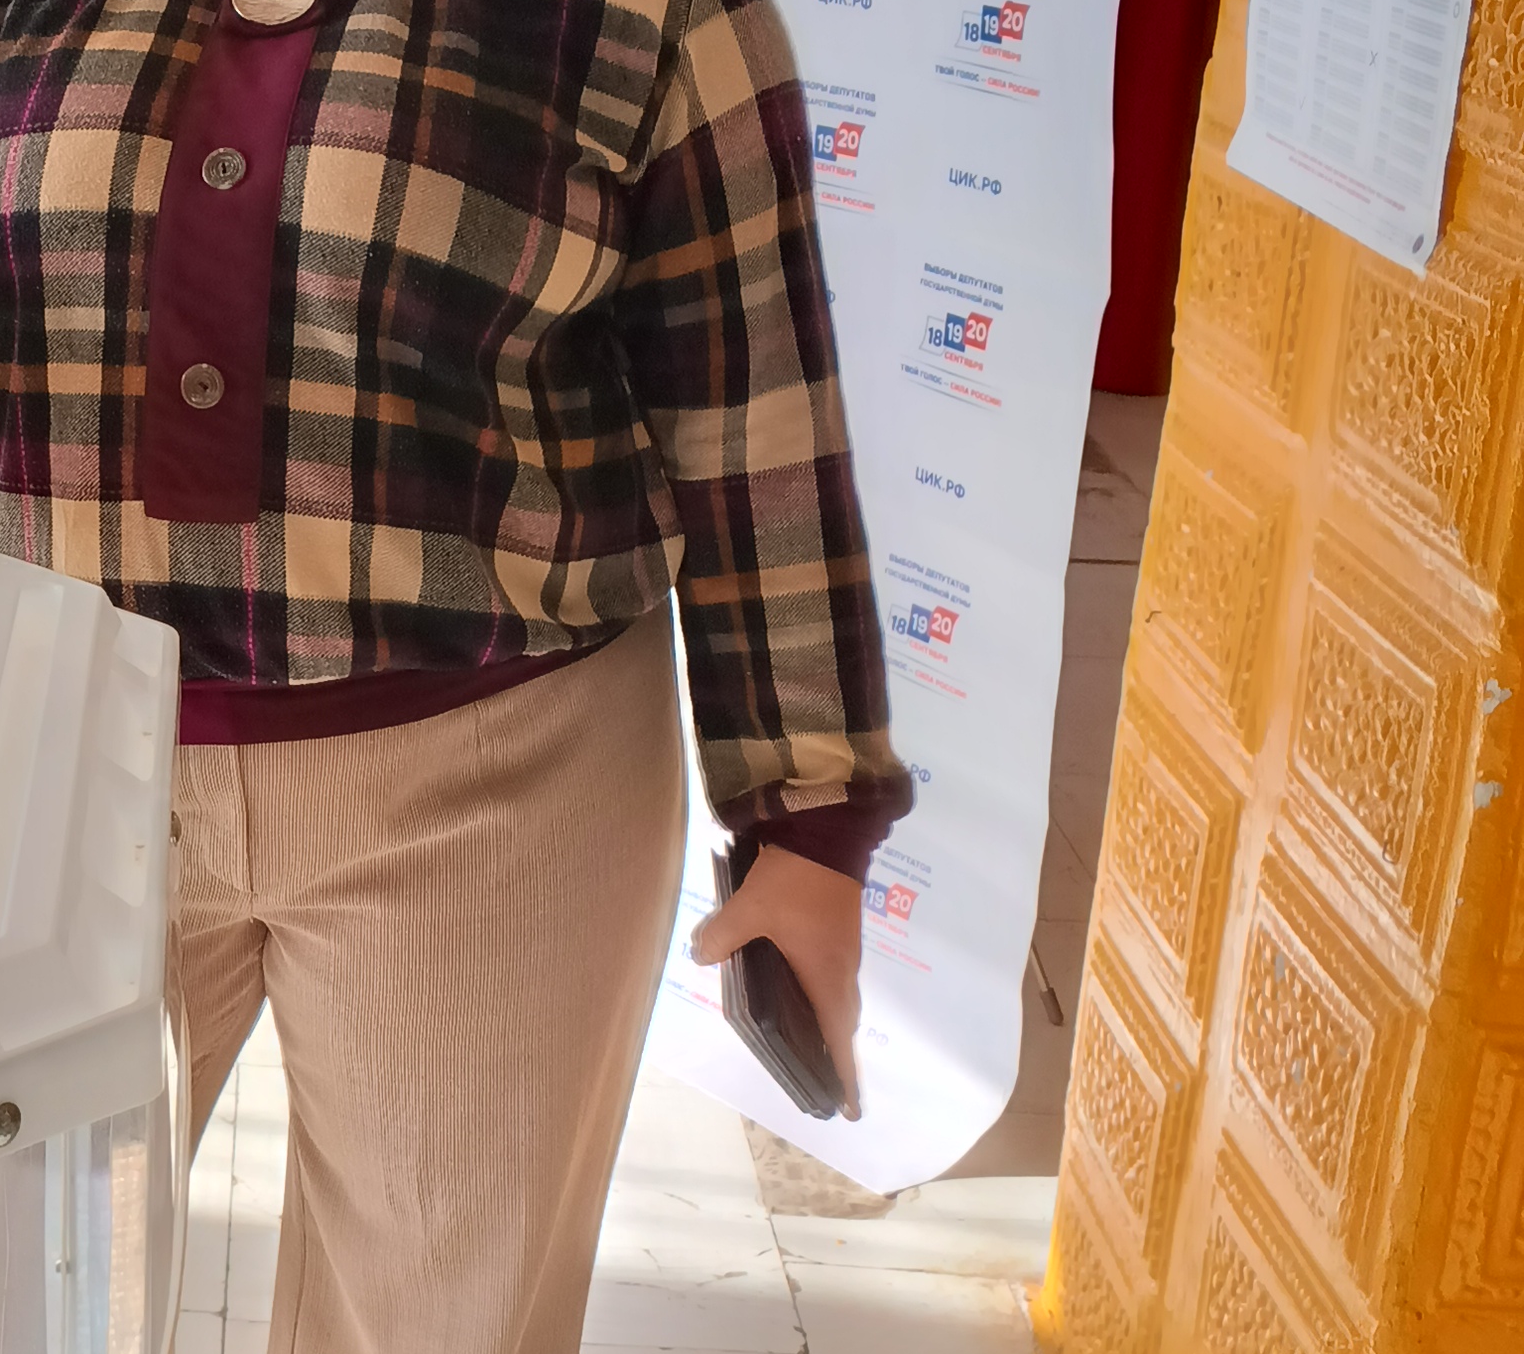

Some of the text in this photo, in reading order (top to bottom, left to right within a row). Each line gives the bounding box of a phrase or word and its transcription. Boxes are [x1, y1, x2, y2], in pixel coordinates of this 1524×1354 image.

[964, 9, 1023, 42] 18 19 20
[817, 129, 859, 153] 19 20
[949, 167, 1002, 195] ЦИК.РФ
[928, 319, 987, 347] 18 19 20
[915, 466, 965, 499] ЦИК.РФ
[891, 612, 952, 635] 18 19 20
[868, 888, 912, 912] 19 20
